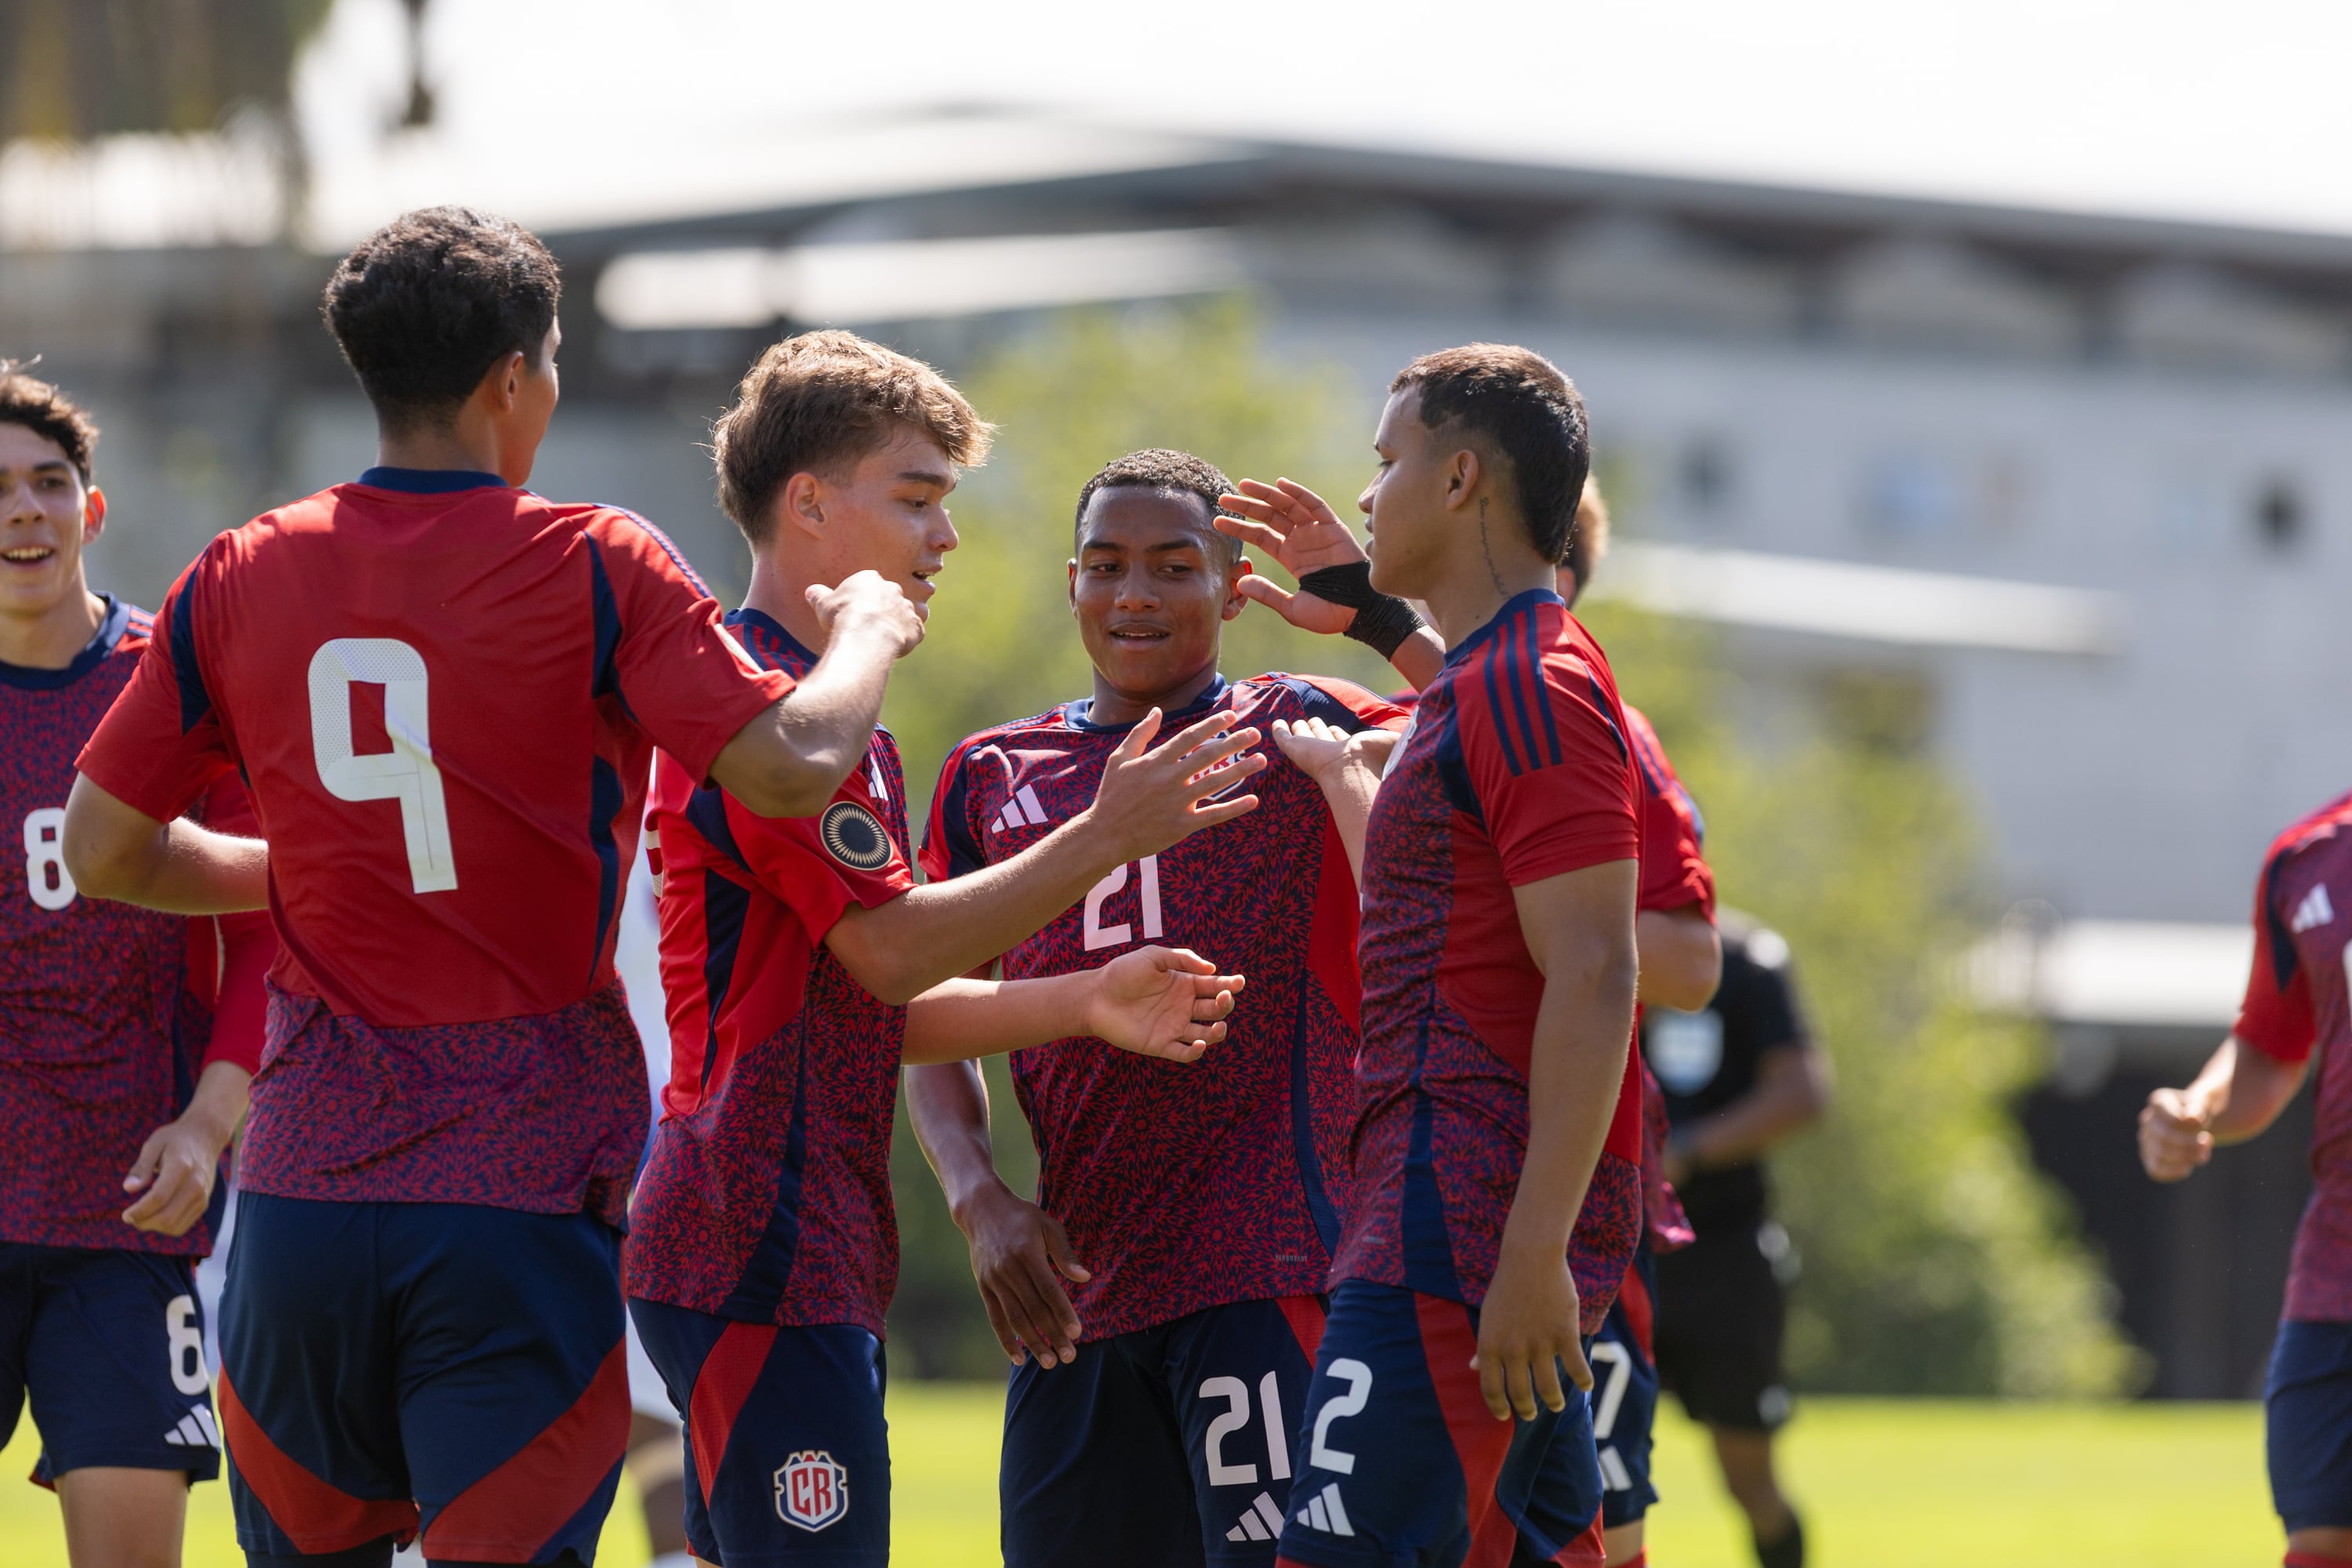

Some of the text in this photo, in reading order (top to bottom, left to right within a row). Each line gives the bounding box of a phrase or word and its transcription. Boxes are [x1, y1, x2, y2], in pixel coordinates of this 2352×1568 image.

[307, 637, 458, 894] 9
[24, 808, 77, 911] 8
[1083, 853, 1163, 951] 21
[1199, 1370, 1291, 1486] 21
[1310, 1357, 1373, 1475] 2
[1591, 1341, 1632, 1439] 7
[791, 1467, 832, 1518] CR
